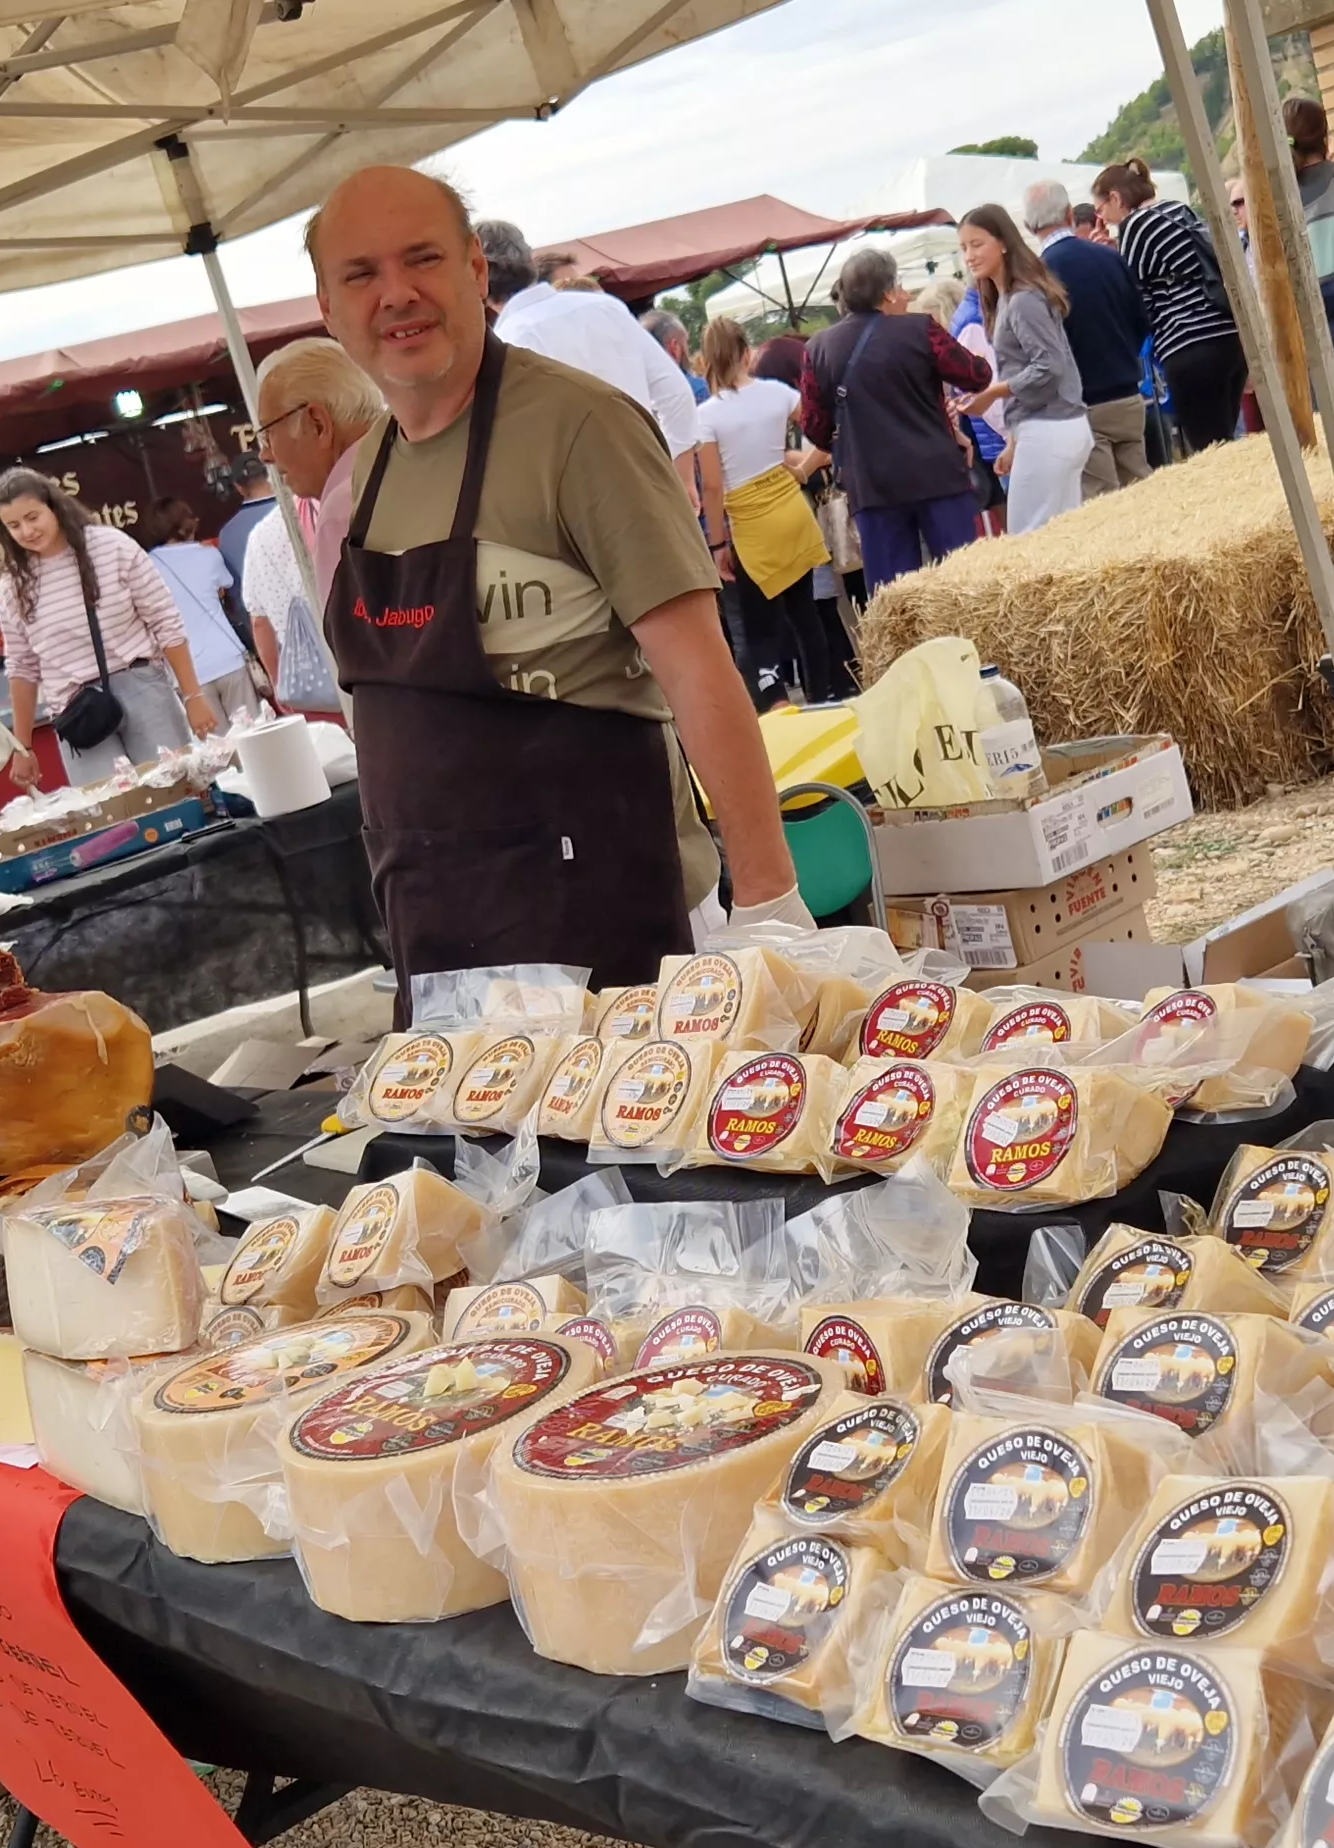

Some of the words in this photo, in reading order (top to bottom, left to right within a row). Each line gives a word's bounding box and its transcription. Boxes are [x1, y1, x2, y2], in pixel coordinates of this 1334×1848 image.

[376, 605, 434, 628] Jabugo
[1068, 887, 1107, 917] FUENTE
[895, 983, 927, 996] QUESO
[936, 987, 951, 1011] OVEJA
[997, 1010, 1027, 1037] QUESO
[1029, 1008, 1041, 1016] DE
[1041, 1008, 1063, 1027] OVEJA
[1020, 1017, 1047, 1027] CURADO
[1153, 1000, 1183, 1023] QUESO
[1186, 999, 1197, 1007] DE
[673, 1017, 718, 1034] RAMOS
[876, 1029, 919, 1054] RAMOS
[627, 1048, 654, 1071] QUESO
[736, 1062, 767, 1084] QUESO
[769, 1060, 781, 1068] DE
[782, 1061, 800, 1083] OVEJA
[382, 1088, 425, 1099] RAMOS
[466, 1090, 504, 1101] RAMOS
[872, 1072, 902, 1092] QUESO
[914, 1074, 930, 1101] OVEJA
[987, 1080, 1020, 1110] QUESO
[1022, 1075, 1036, 1084] DE
[1038, 1075, 1066, 1095] OVEJA
[1013, 1086, 1045, 1097] CURADO
[616, 1105, 662, 1121] RAMOS
[726, 1118, 777, 1134] RAMOS
[853, 1128, 898, 1149] RAMOS
[990, 1142, 1051, 1163] RAMOS
[1250, 1163, 1286, 1190] QUESO
[1288, 1161, 1299, 1169] DE
[1302, 1163, 1327, 1188] OVEJA
[1283, 1172, 1306, 1181] VIEJO
[339, 1246, 373, 1264] RAMOS
[1111, 1244, 1151, 1270] QUESO
[1146, 1255, 1169, 1264] VIEJO
[514, 1288, 537, 1310] OVEJA
[652, 1317, 682, 1347] QUESO
[697, 1315, 716, 1342] OVEJA
[961, 1308, 1002, 1335] QUESO
[1005, 1305, 1020, 1314] DE
[997, 1317, 1023, 1326] VIEJO
[595, 1328, 613, 1356] OVEJA
[813, 1328, 833, 1354] QUESO
[835, 1326, 846, 1335] DE
[848, 1329, 870, 1358] OVEJA
[1133, 1320, 1178, 1349] QUESO
[1181, 1320, 1196, 1330] DE
[1199, 1322, 1230, 1356] OVEJA
[1173, 1332, 1202, 1344] VIEJO
[512, 1345, 534, 1356] DE
[531, 1348, 553, 1382] OVEJA
[646, 1363, 733, 1386] QUESO
[740, 1362, 771, 1375] DE
[345, 1396, 439, 1432] RAMOS
[835, 1408, 878, 1435] QUESO
[869, 1418, 896, 1433] VIEJO
[566, 1421, 680, 1453] RAMOS
[977, 1435, 1025, 1471] QUESO
[1026, 1435, 1043, 1449] DE
[1042, 1436, 1083, 1479] OVEJA
[1020, 1449, 1048, 1466] VIEJO
[1169, 1495, 1223, 1531] QUESO
[1223, 1490, 1243, 1504] DE
[1244, 1492, 1284, 1526] OVEJA
[1215, 1505, 1247, 1518] VIEJO
[765, 1540, 808, 1568] QUESO
[808, 1541, 822, 1555] DE
[819, 1544, 846, 1587] OVEJA
[801, 1554, 826, 1571] VIEJO
[921, 1596, 970, 1634] QUESO
[971, 1596, 988, 1612] DE
[990, 1598, 1028, 1641] OVEJA
[965, 1612, 997, 1628] VIEJO
[1099, 1656, 1152, 1694] QUESO
[1155, 1656, 1177, 1672] DE
[1179, 1664, 1224, 1710] OVEJA
[1147, 1673, 1185, 1690] VIEJO
